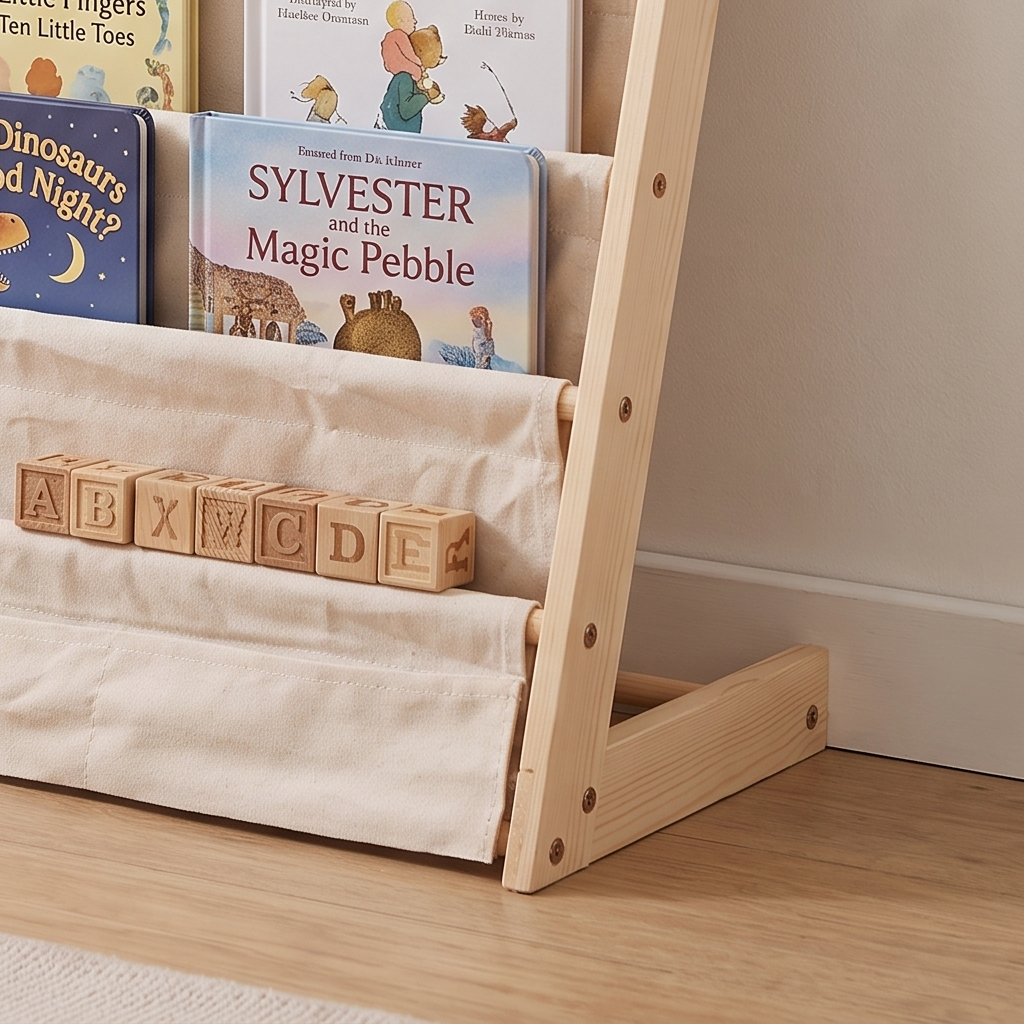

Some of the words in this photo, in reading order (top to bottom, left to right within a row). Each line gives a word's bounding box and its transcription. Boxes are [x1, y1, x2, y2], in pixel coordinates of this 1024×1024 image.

[38, 18, 86, 42] Little
[91, 22, 135, 46] Toes
[512, 12, 525, 26] by
[339, 150, 362, 163] from
[30, 166, 122, 241] Night?
[248, 164, 474, 225] SYLVESTER
[329, 218, 358, 234] and
[364, 220, 390, 237] the
[247, 227, 349, 277] Magic
[361, 240, 475, 286] Pebble
[26, 478, 60, 519] A
[85, 486, 116, 527] B
[151, 495, 178, 540] X
[268, 512, 303, 555] C
[330, 522, 365, 563] D
[391, 529, 430, 573] E
